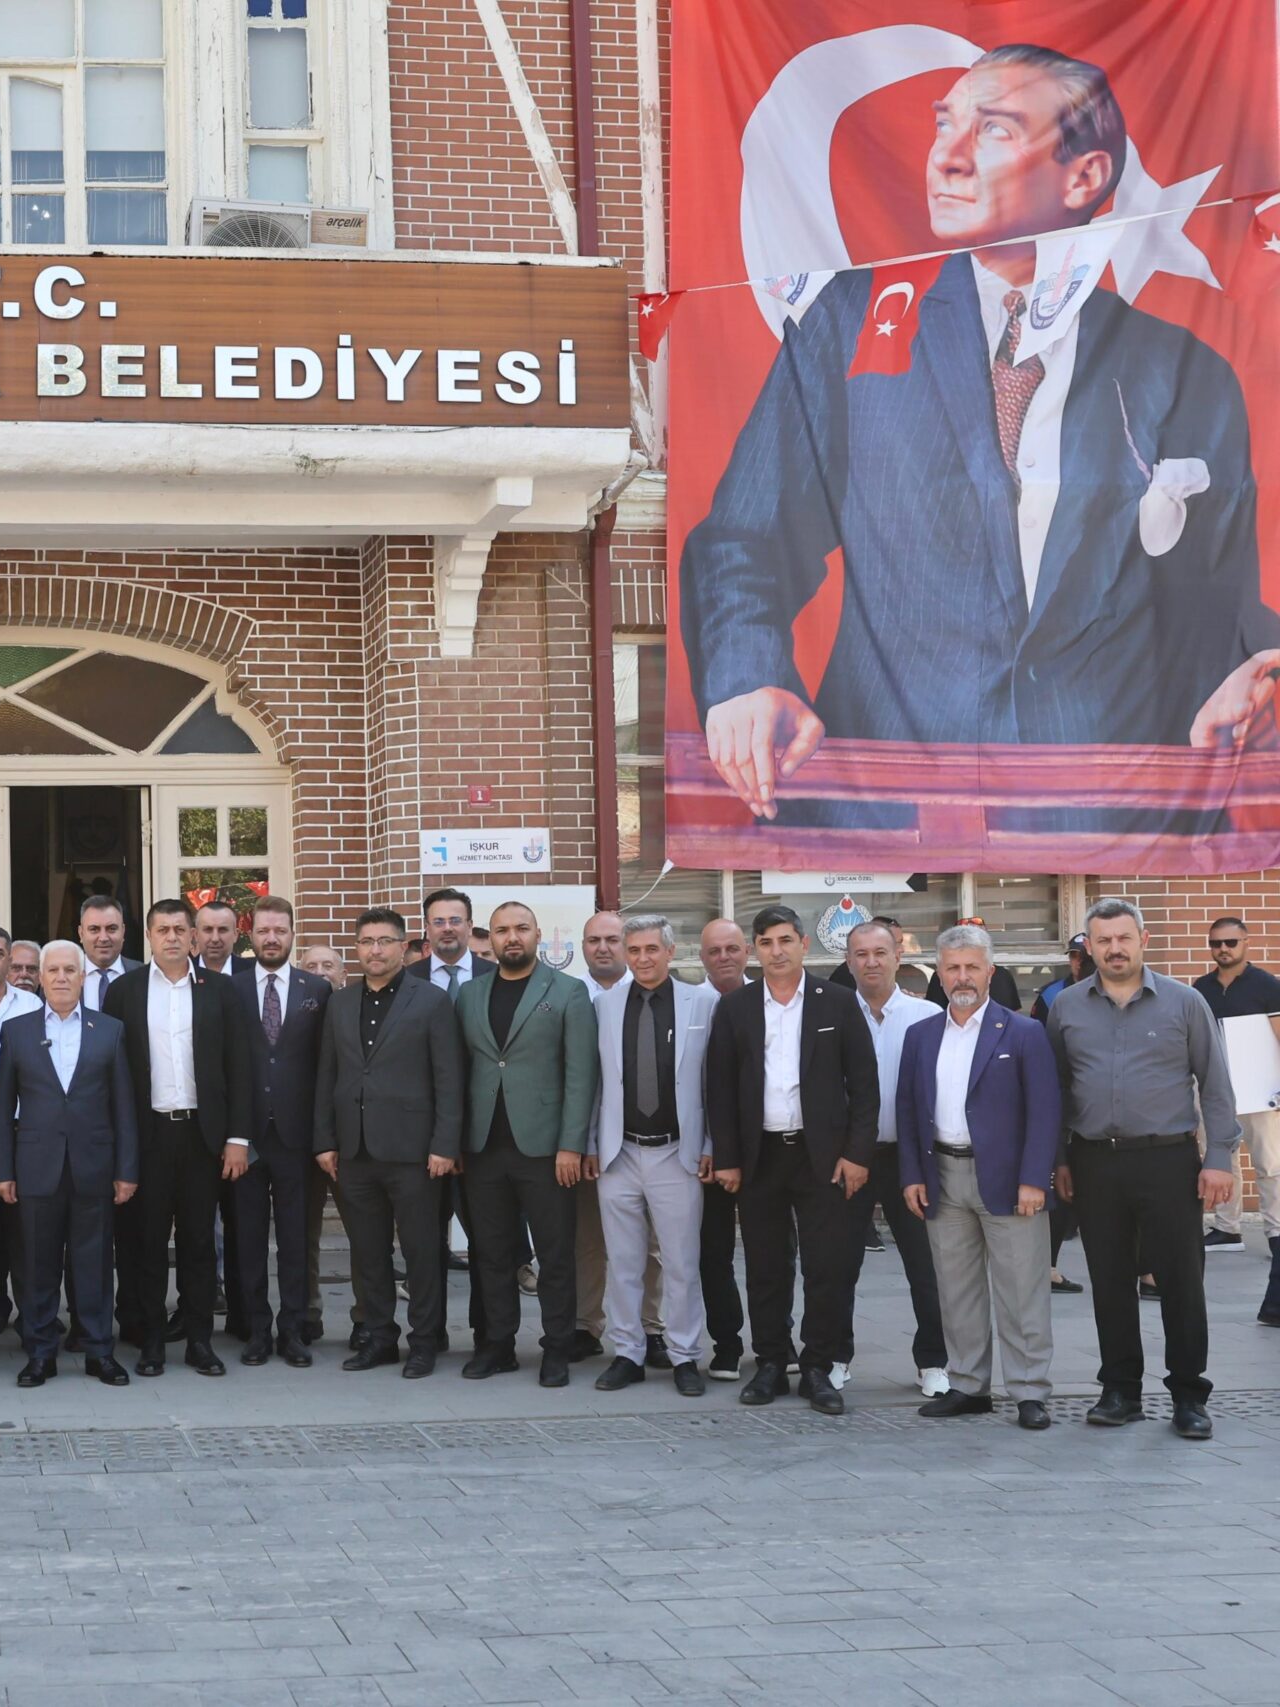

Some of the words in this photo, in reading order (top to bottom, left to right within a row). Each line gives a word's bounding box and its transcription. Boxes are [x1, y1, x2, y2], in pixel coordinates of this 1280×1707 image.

[326, 217, 364, 229] arçelik
[37, 334, 577, 406] BELEDİYESİ
[477, 790, 484, 801] 1
[469, 841, 499, 852] İŞKUR
[457, 854, 482, 862] HİZMET
